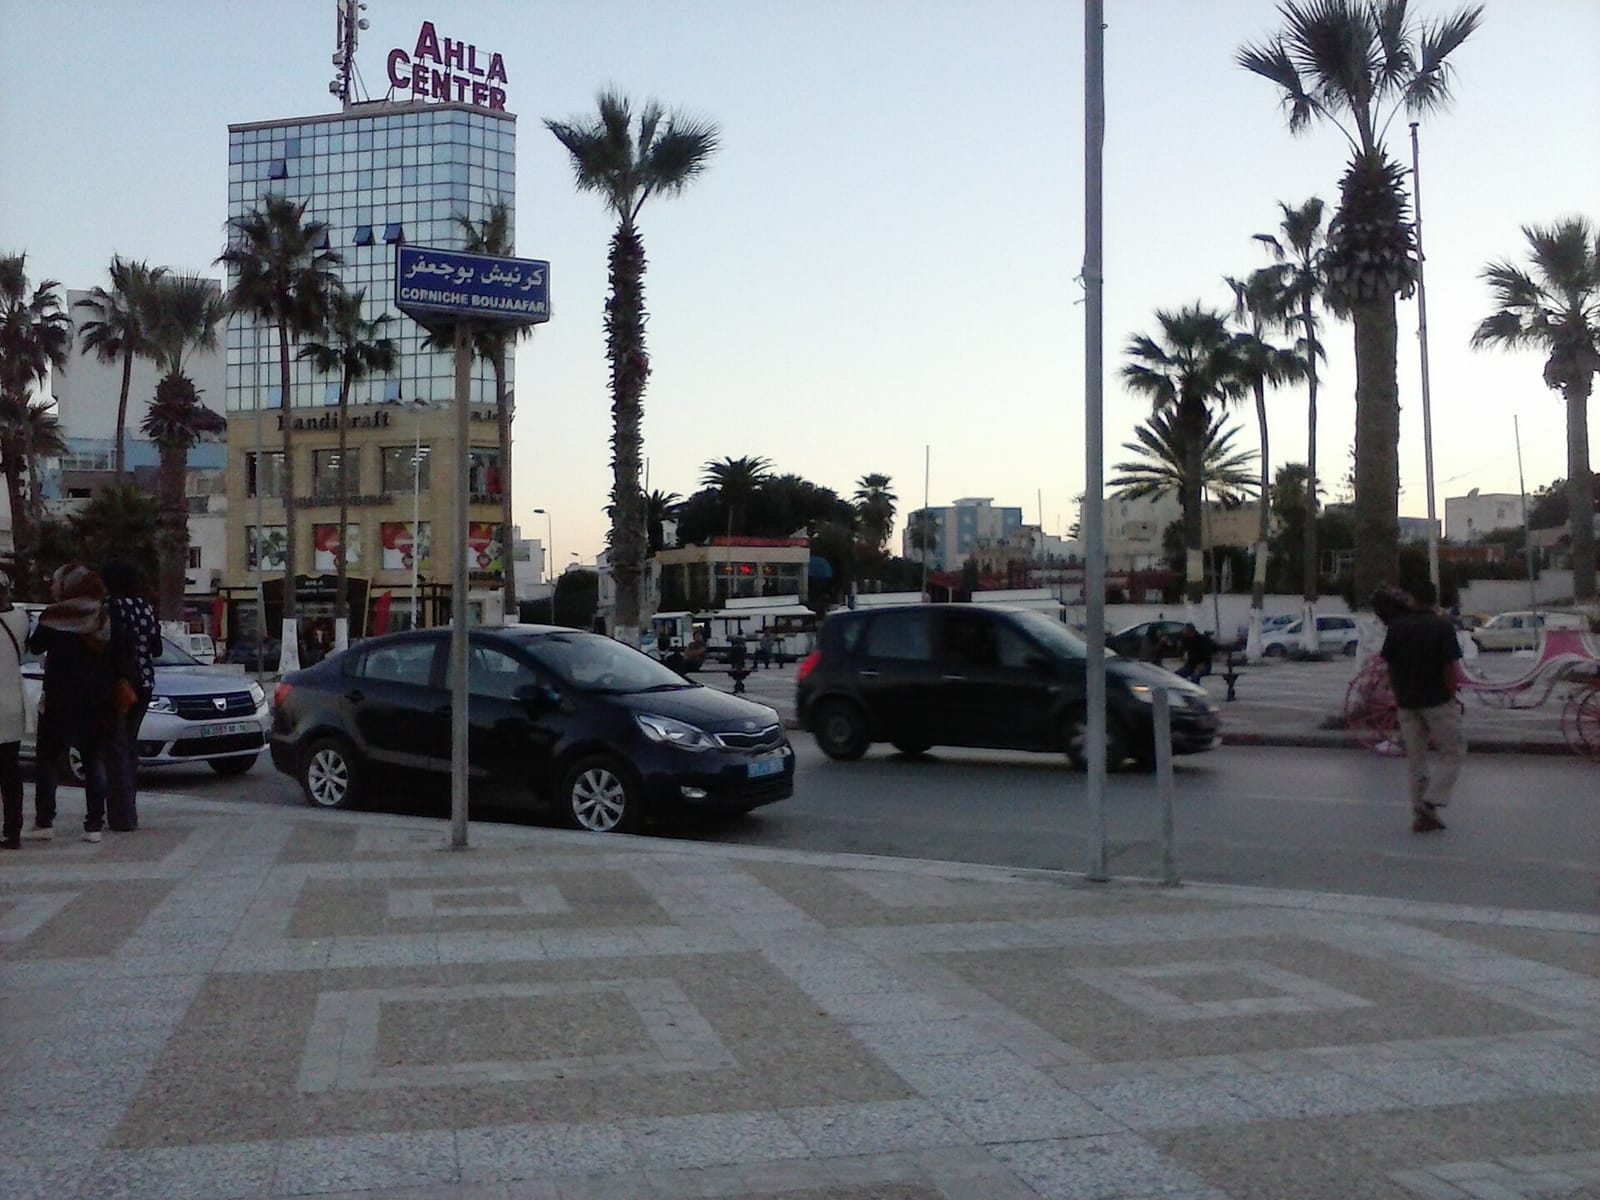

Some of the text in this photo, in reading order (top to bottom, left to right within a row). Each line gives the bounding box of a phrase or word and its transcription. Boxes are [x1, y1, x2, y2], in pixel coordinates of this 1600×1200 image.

[414, 21, 508, 84] AHLA
[387, 48, 507, 112] CENTER
[404, 255, 544, 291] كرنيش بوجعفر
[401, 287, 546, 313] CORNICHE BOUJAAFAR
[277, 410, 390, 431] andiraft
